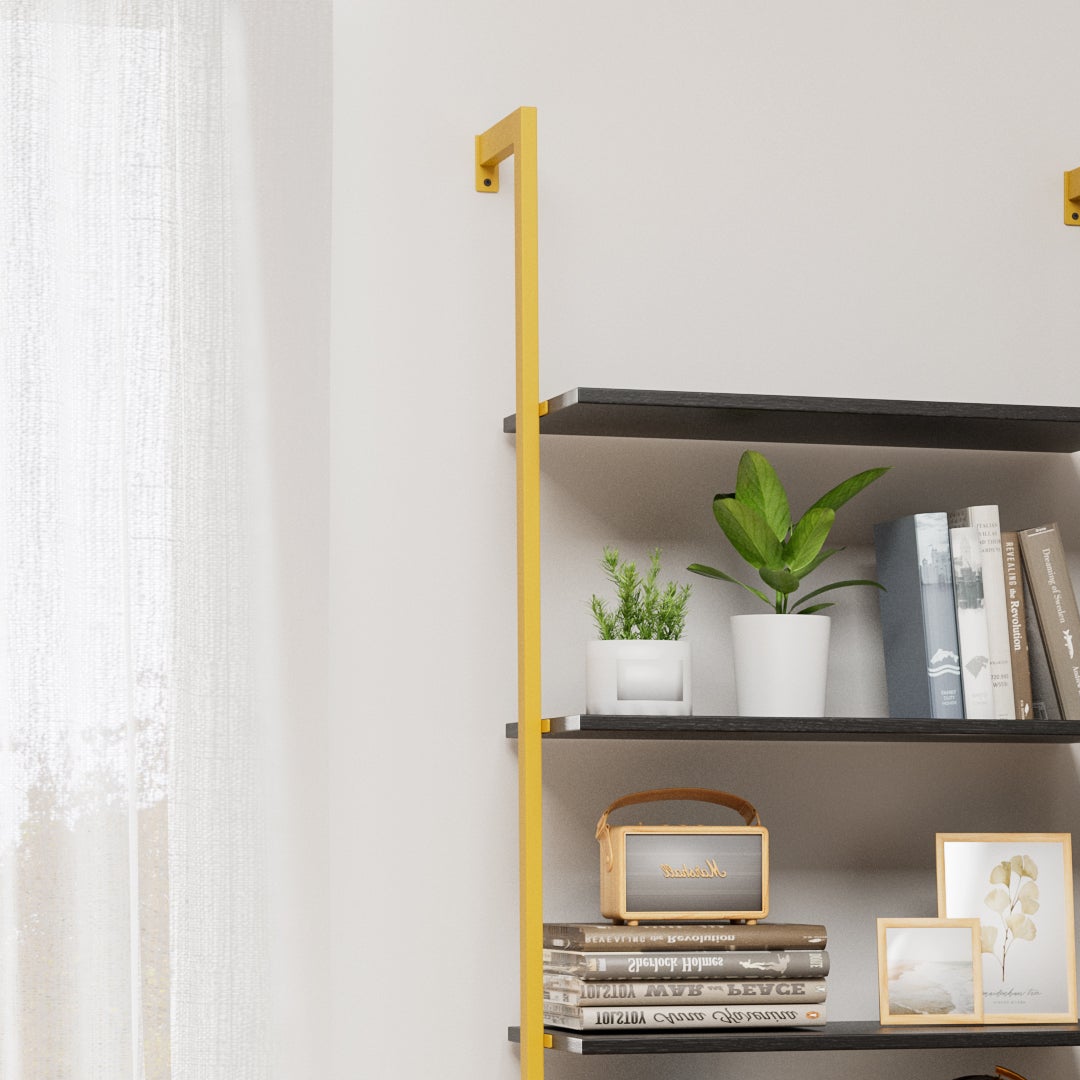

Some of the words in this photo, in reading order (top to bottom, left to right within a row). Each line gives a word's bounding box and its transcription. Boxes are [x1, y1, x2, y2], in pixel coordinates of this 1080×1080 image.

[1005, 541, 1017, 586] REVEALING
[1042, 548, 1056, 586] Dreaming
[1051, 585, 1060, 593] of
[1053, 593, 1066, 623] Sweden
[1010, 600, 1022, 651] Revolution
